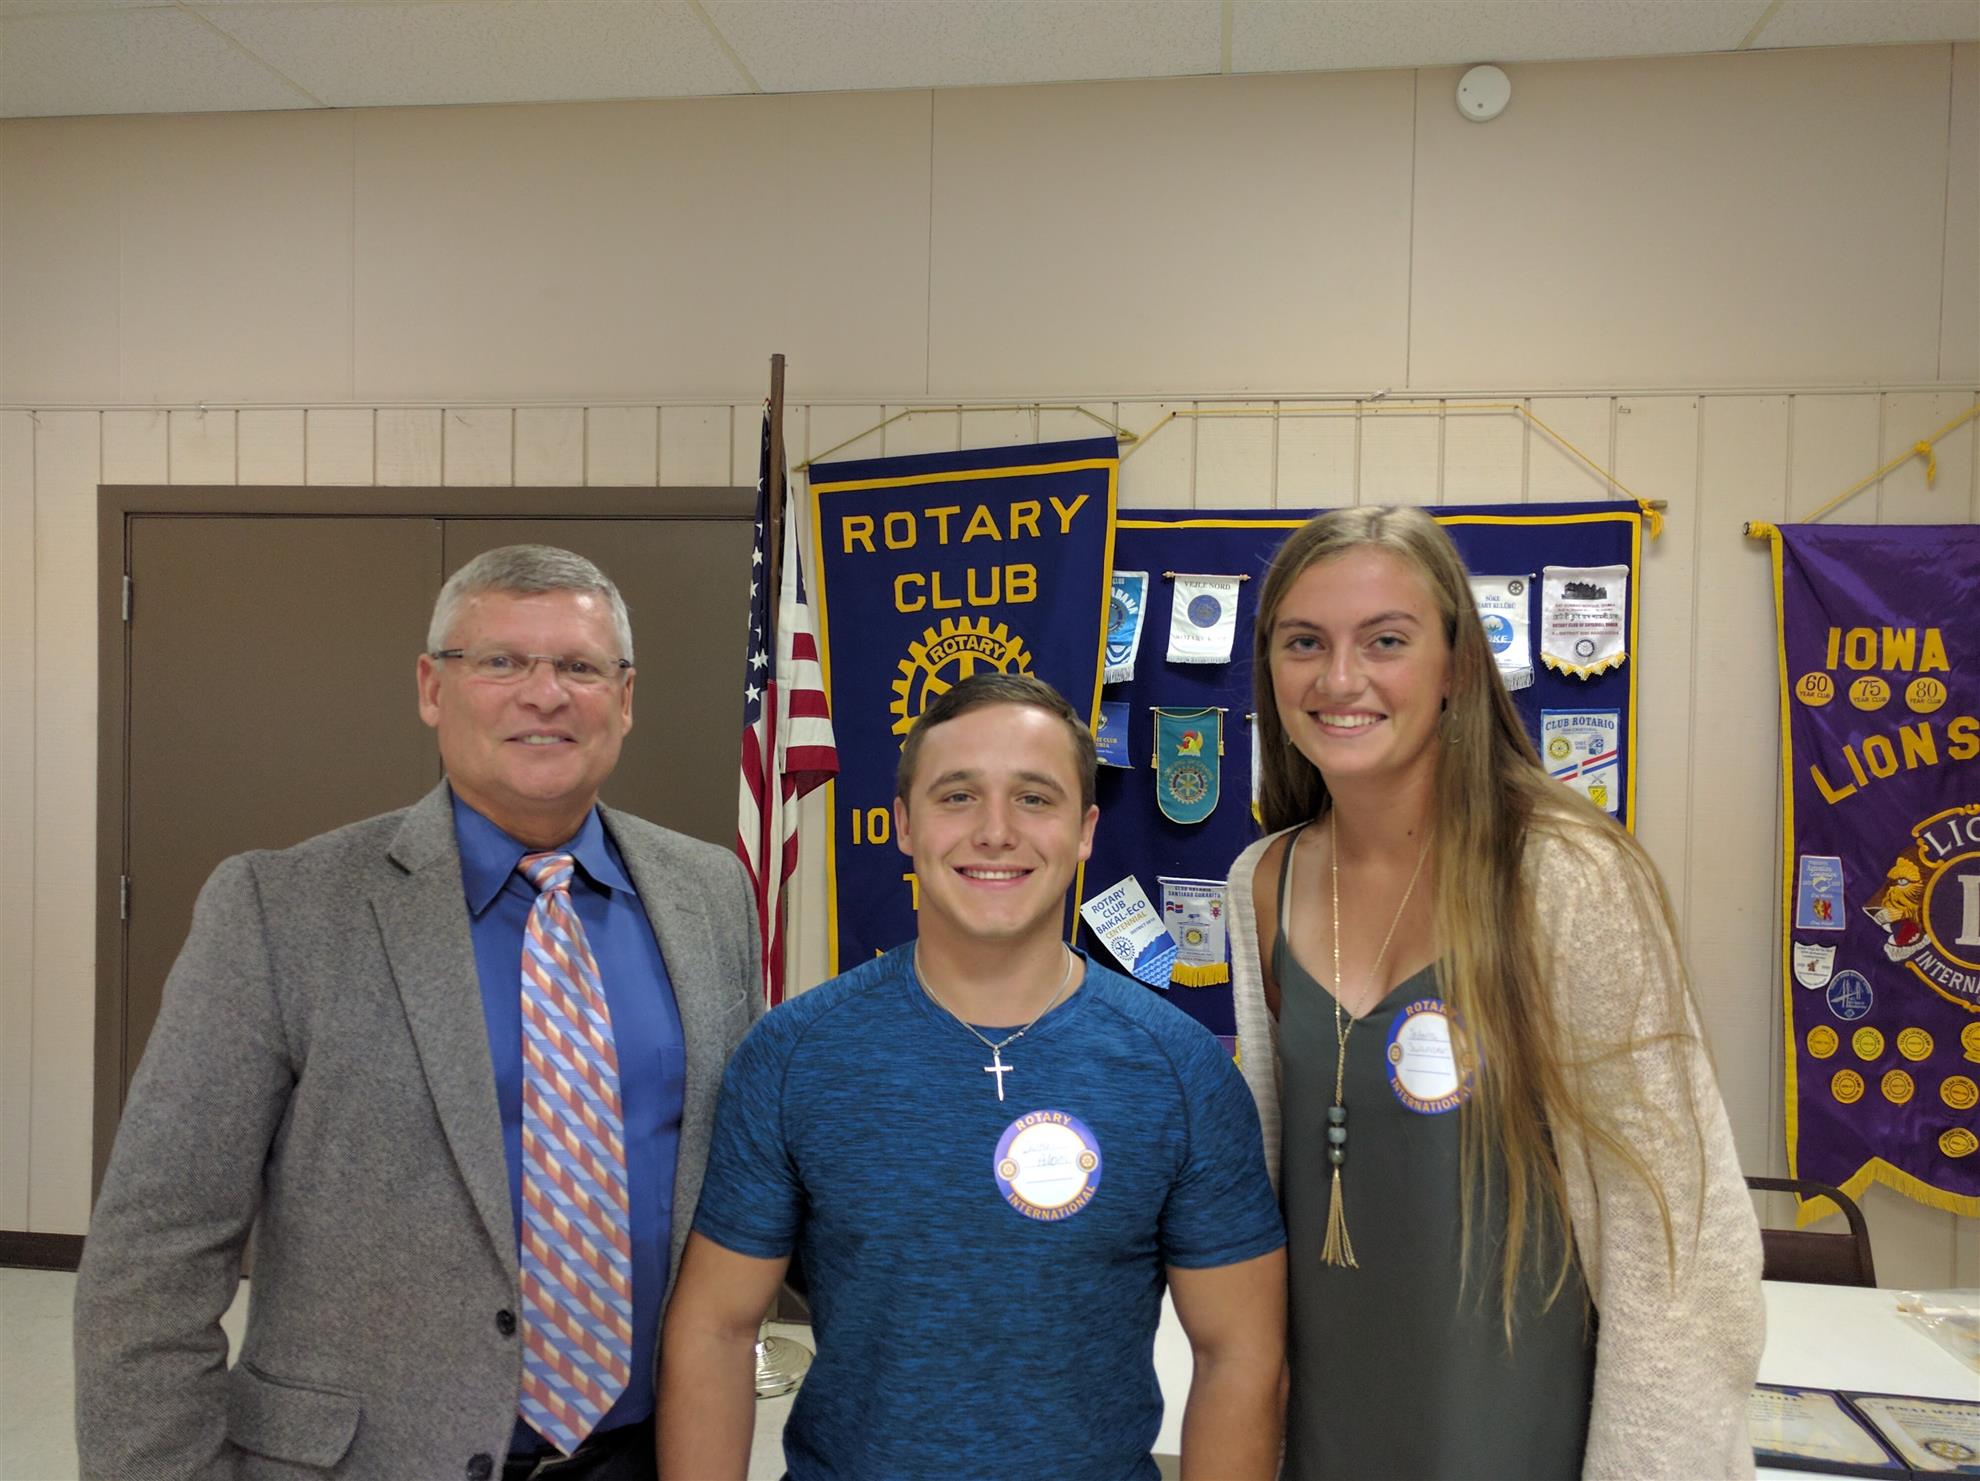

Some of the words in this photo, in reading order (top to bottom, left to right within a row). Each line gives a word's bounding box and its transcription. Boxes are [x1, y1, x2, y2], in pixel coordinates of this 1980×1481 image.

[841, 494, 1090, 554] ROTARY
[893, 563, 1037, 613] CLUB
[1209, 582, 1231, 590] NORD
[929, 635, 1007, 663] ROTARY
[1826, 626, 1950, 672] IOWA
[1805, 674, 1828, 692] 60
[1858, 680, 1881, 697] 75
[1915, 681, 1938, 699] 80
[1545, 718, 1569, 731] CLUB
[1572, 716, 1615, 729] ROTARIO
[1810, 716, 1980, 805] LIONS
[852, 807, 890, 845] IO
[1923, 816, 1980, 857] LIO
[1091, 888, 1126, 913] ROTARY
[1103, 900, 1126, 918] CLUB
[1096, 900, 1146, 934] BAIKAL-ECO
[1106, 911, 1148, 939] CENTENNIAL
[1915, 950, 1980, 995] INTERN
[1015, 1112, 1072, 1131] ROTARY
[1007, 1185, 1096, 1220] INTERNATIONAL
